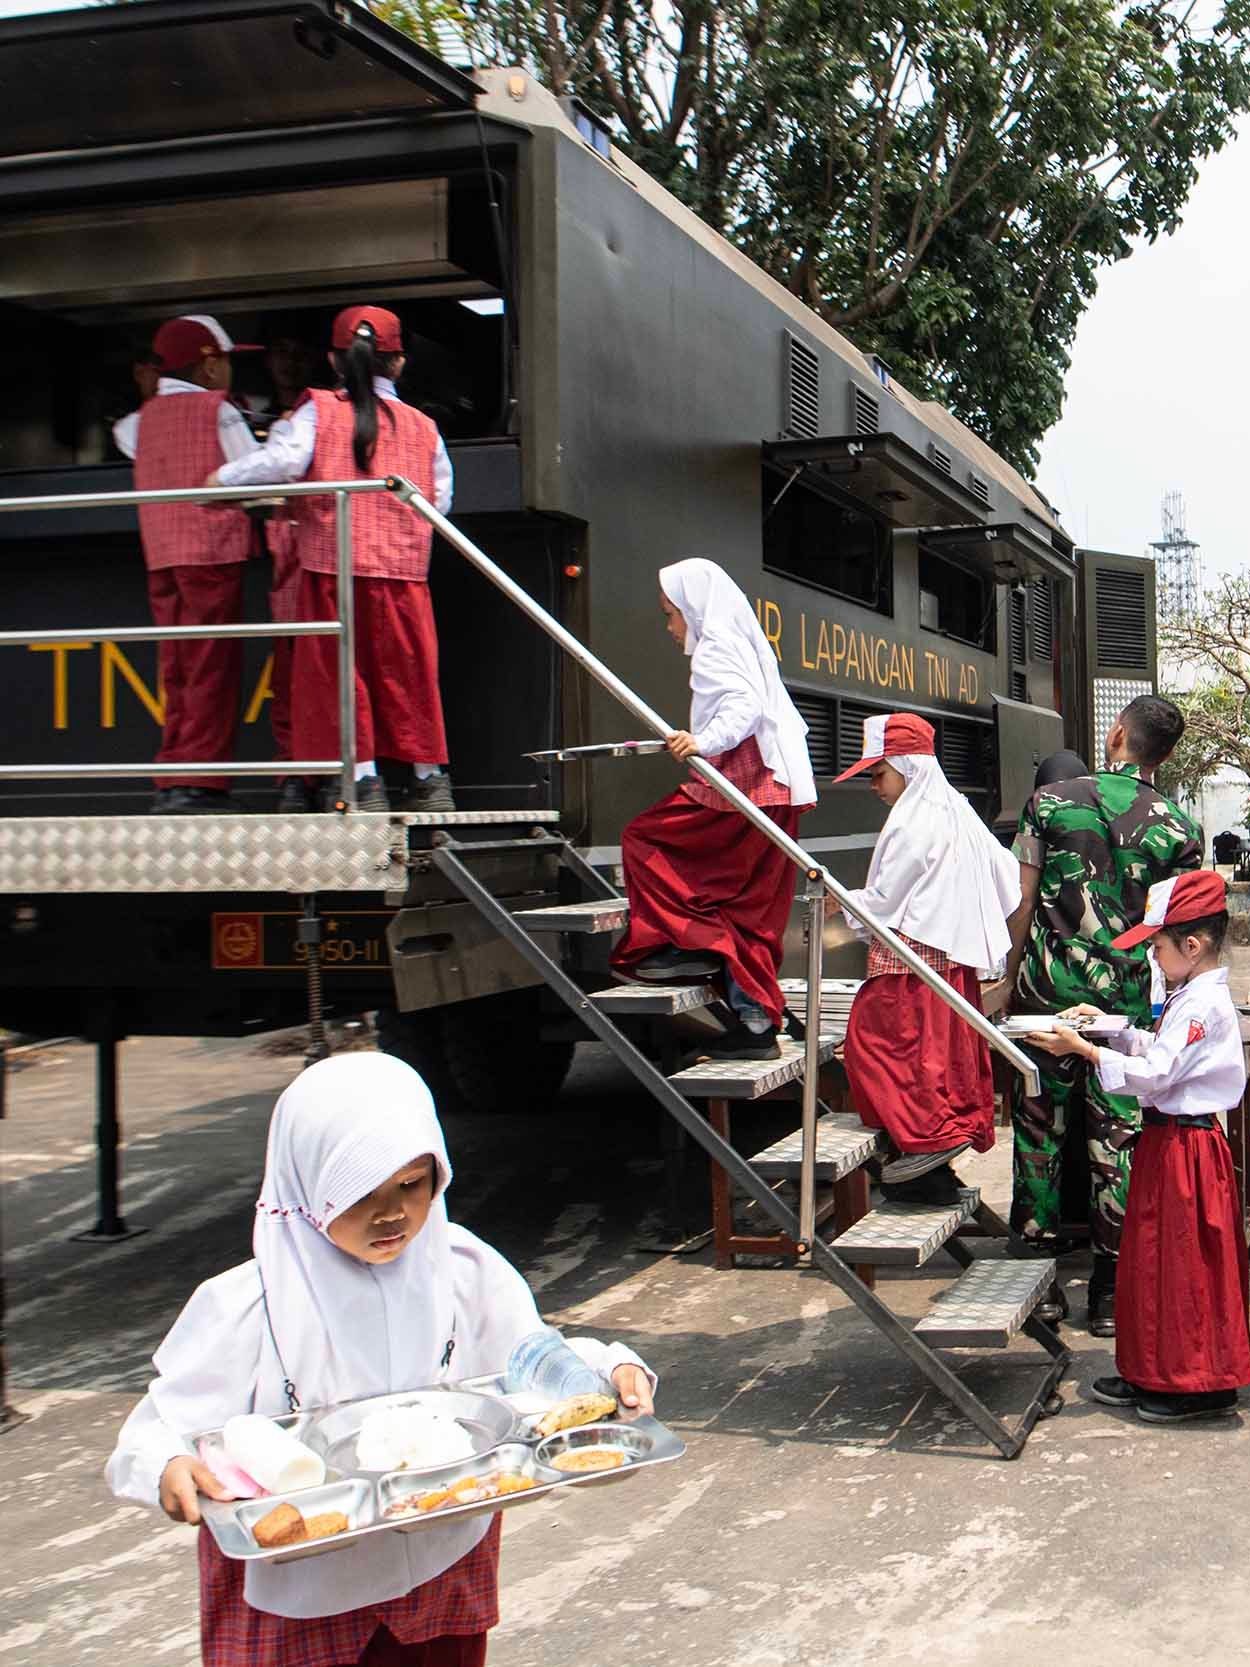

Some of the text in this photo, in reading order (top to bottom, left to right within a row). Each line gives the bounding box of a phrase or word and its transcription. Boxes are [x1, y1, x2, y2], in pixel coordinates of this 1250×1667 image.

[28, 641, 167, 729] TN
[801, 614, 914, 691] LAPANGAN
[925, 652, 950, 700] TNI
[958, 664, 978, 704] AD
